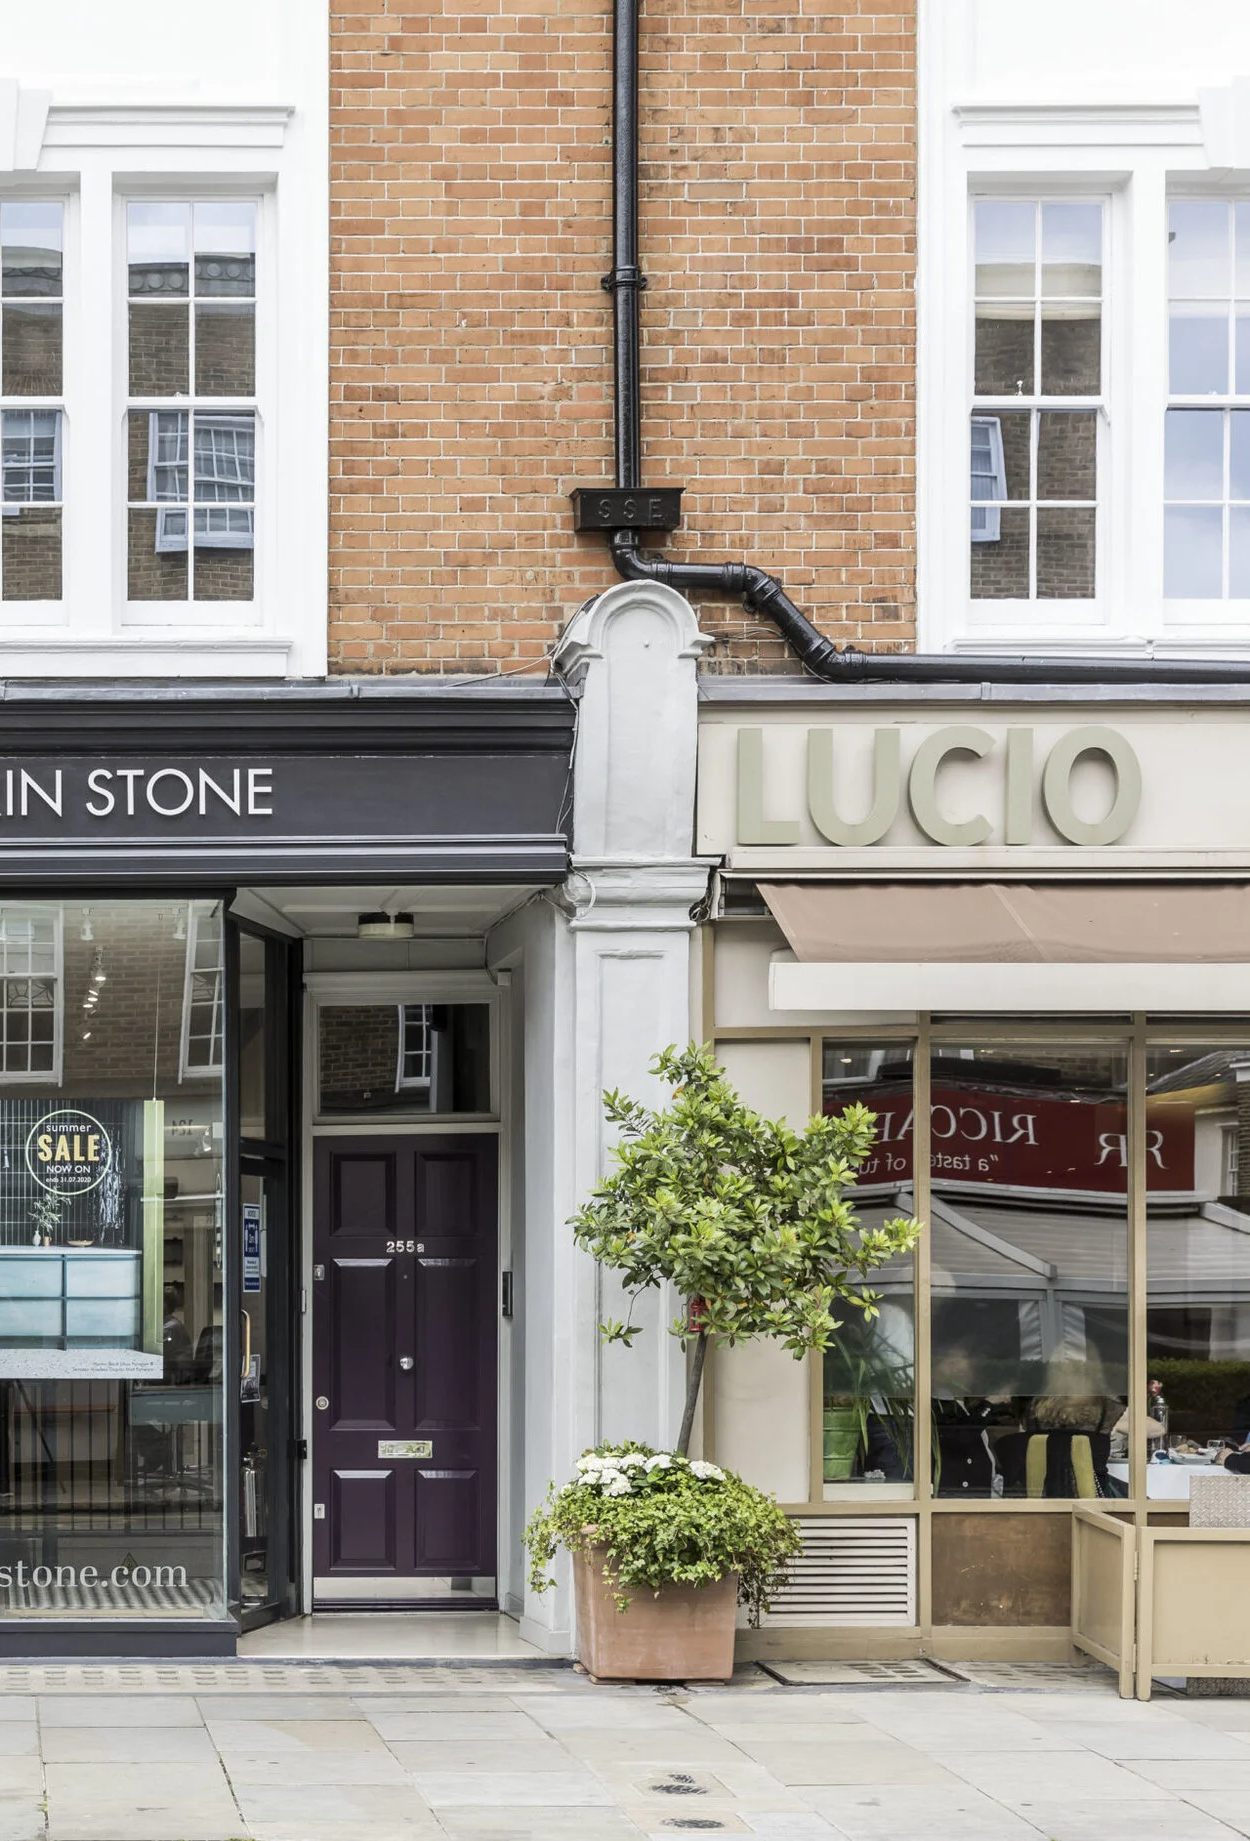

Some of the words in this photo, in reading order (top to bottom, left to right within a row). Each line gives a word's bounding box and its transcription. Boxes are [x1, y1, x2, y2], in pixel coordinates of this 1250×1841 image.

[85, 768, 273, 817] STONE
[736, 725, 1143, 847] LUCIO
[46, 1124, 92, 1132] summer
[37, 1134, 101, 1162] SALE
[46, 1165, 73, 1174] NOW
[74, 1165, 91, 1174] ON
[386, 1240, 425, 1253] 255a
